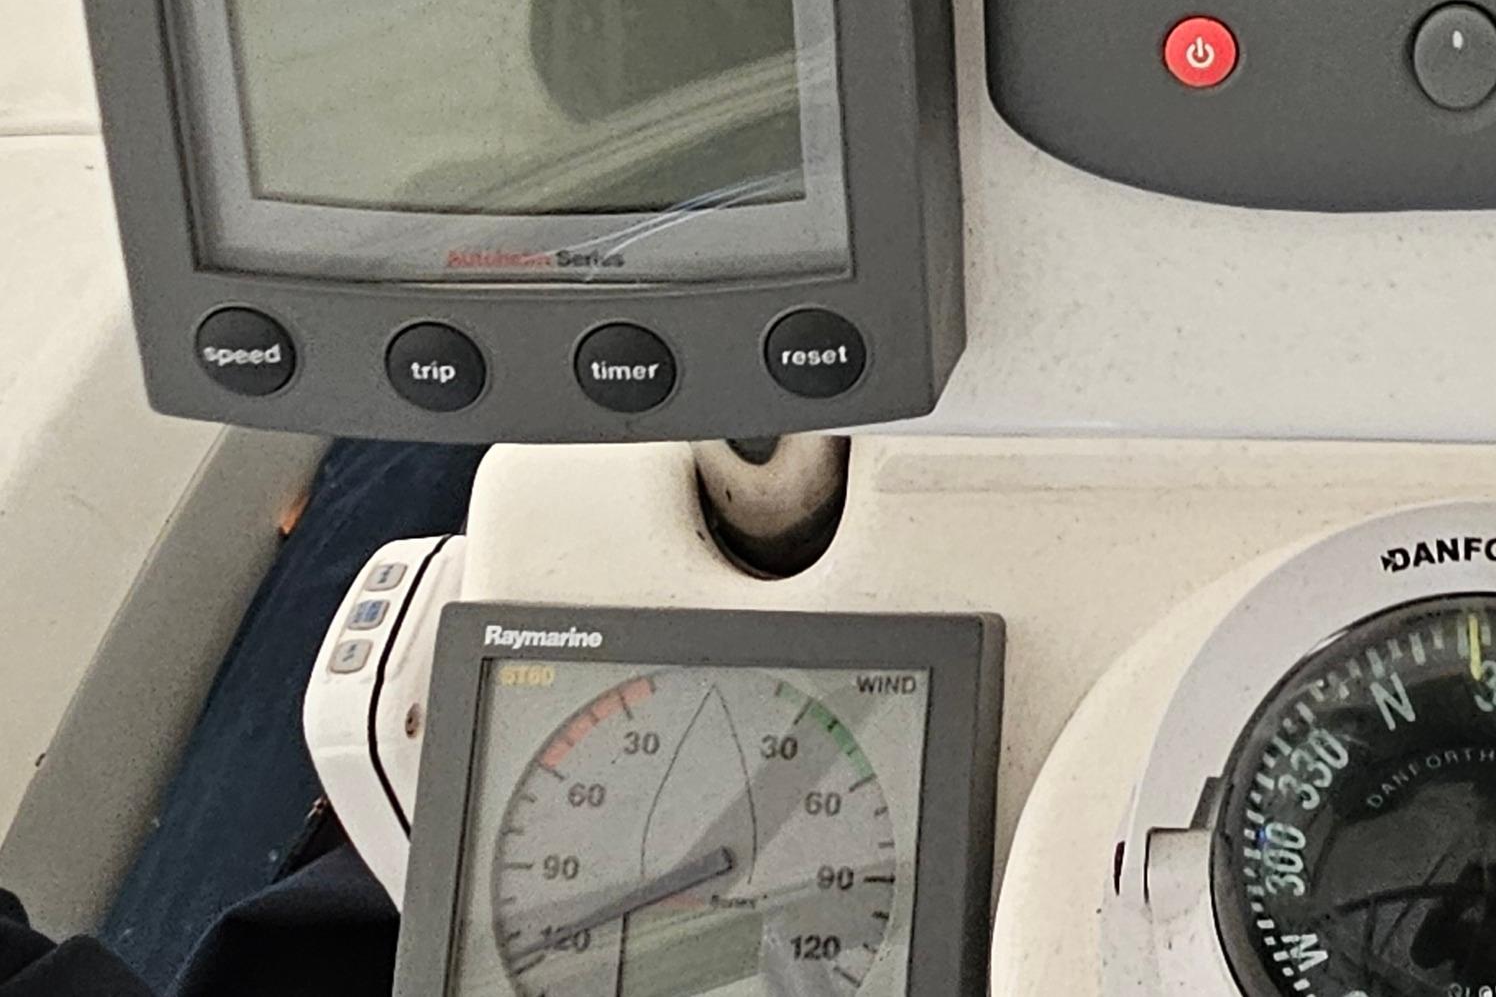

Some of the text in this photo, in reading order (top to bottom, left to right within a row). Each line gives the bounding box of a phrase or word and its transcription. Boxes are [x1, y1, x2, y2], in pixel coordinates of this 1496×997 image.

[203, 342, 282, 367] speed
[781, 345, 848, 366] reset
[410, 360, 456, 384] trip
[590, 359, 660, 381] timer
[484, 624, 603, 650] Raymarine
[855, 674, 917, 695] WIND
[1369, 670, 1416, 732] N
[622, 730, 661, 755] 30
[760, 735, 799, 760] 30
[1277, 727, 1349, 810] 330
[567, 782, 607, 808] 60
[803, 790, 842, 817] 60
[542, 854, 580, 881] 90
[1264, 821, 1307, 897] 300
[816, 865, 855, 891] 90
[790, 934, 842, 961] 120
